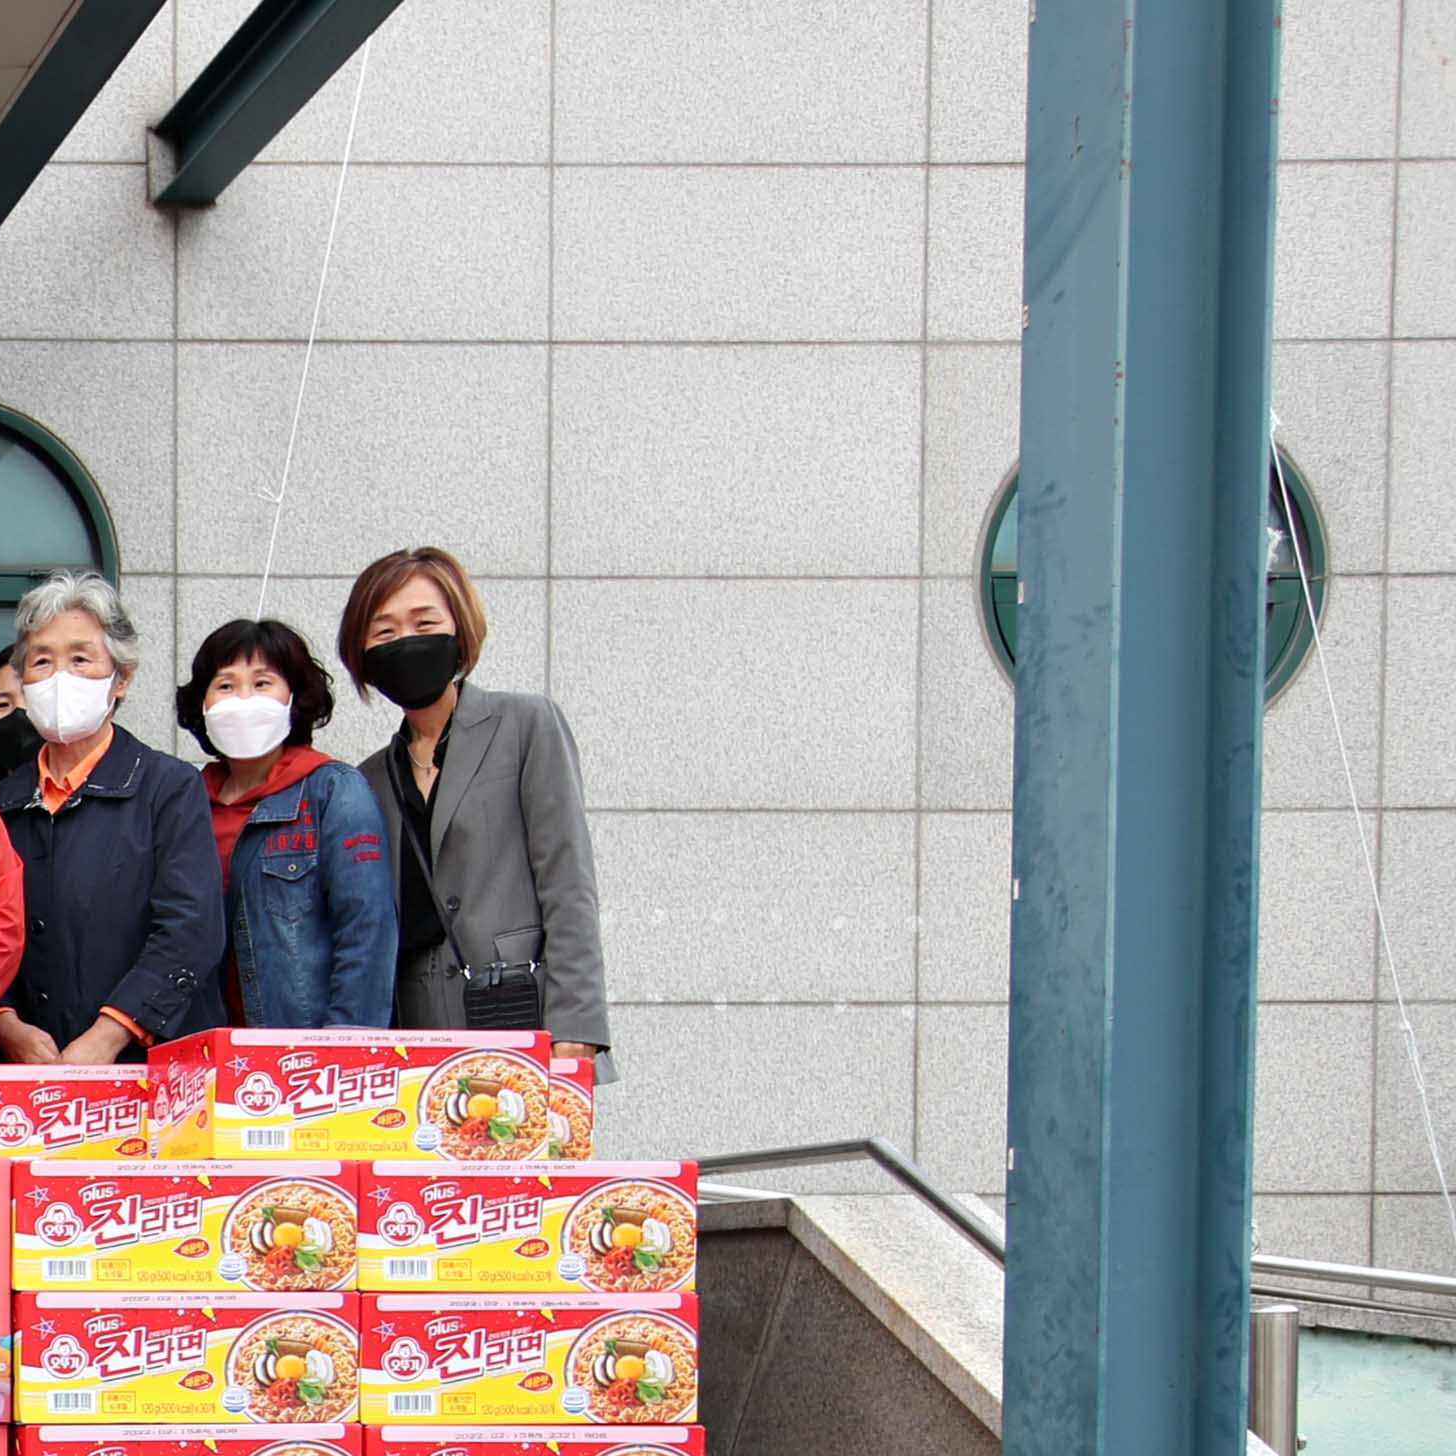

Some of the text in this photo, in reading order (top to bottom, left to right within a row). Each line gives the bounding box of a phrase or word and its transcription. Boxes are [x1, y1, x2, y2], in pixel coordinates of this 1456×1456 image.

[287, 1065, 399, 1118] 진라면
[36, 1098, 141, 1148] 진라면
[88, 1195, 202, 1249] 진라면
[430, 1195, 542, 1248] 진라면
[93, 1327, 207, 1381] 진라면
[434, 1329, 546, 1382] 진라면
